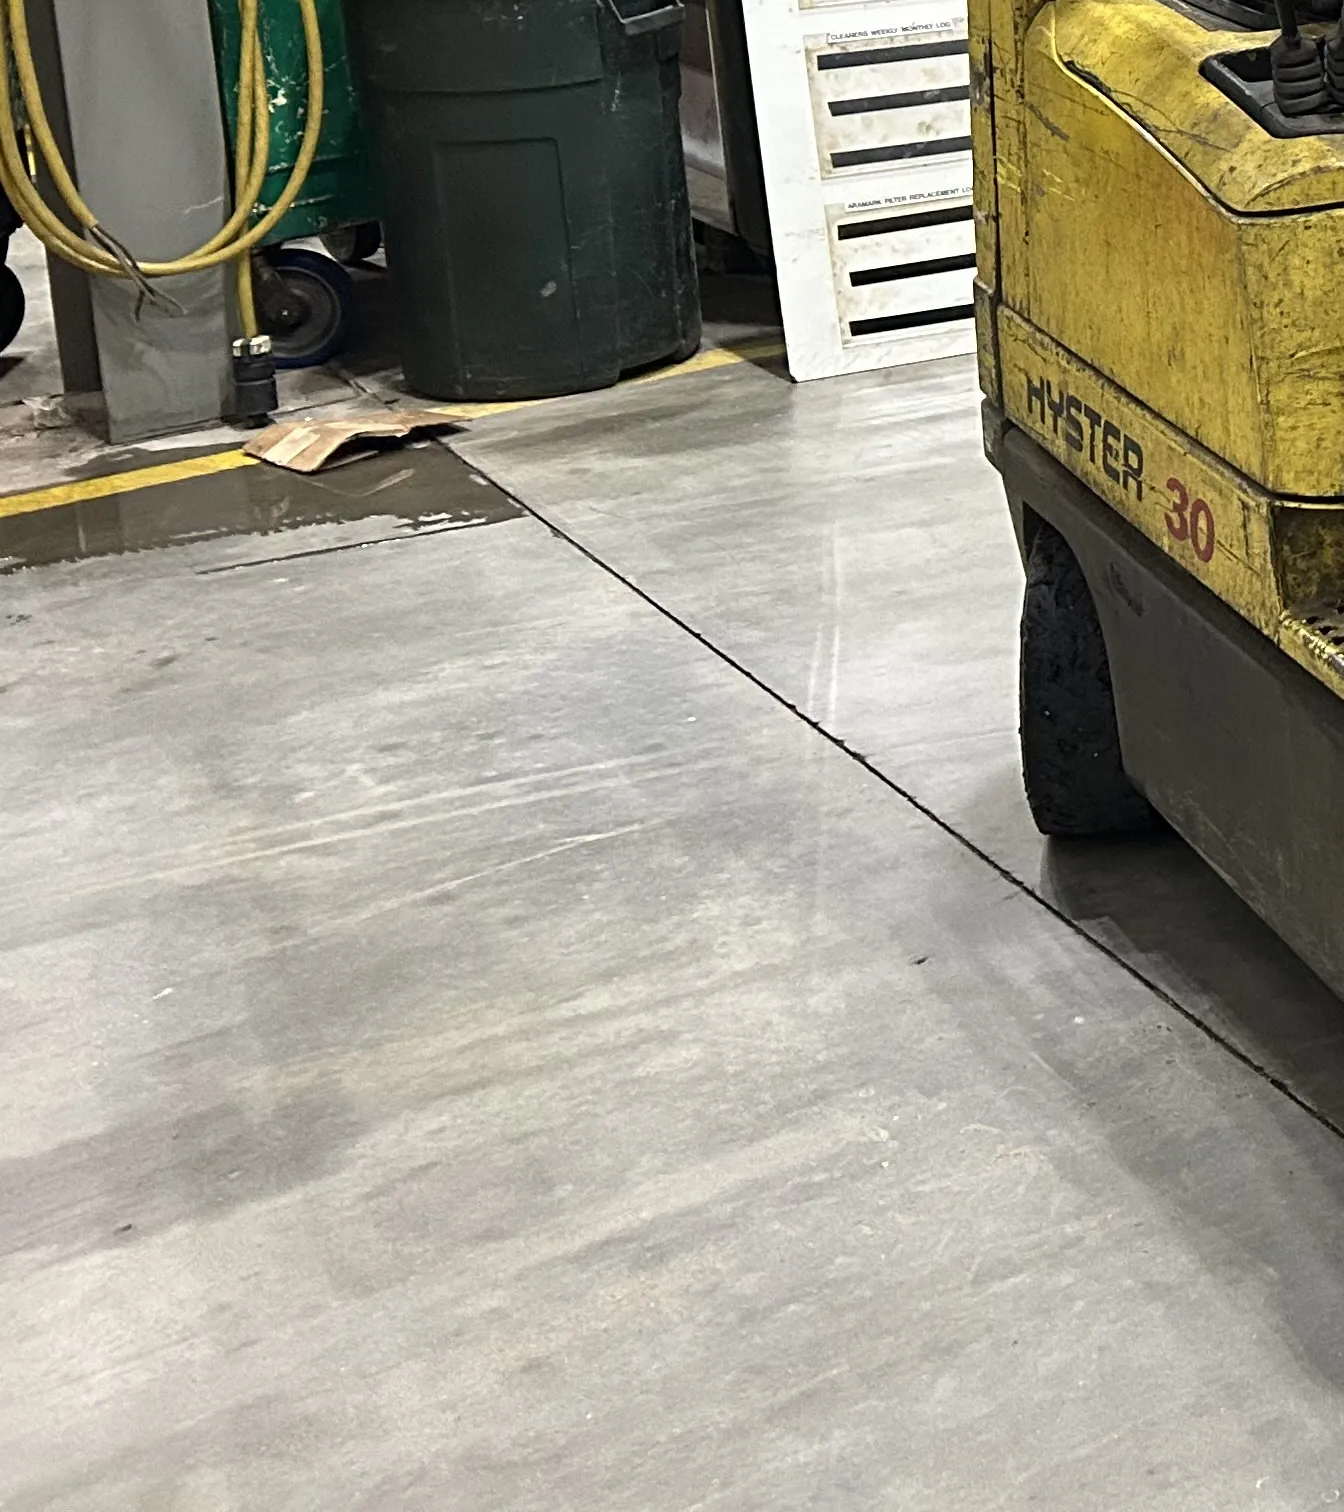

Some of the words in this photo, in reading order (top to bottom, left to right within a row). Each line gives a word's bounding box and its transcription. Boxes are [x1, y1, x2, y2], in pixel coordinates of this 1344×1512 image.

[830, 30, 869, 41] CLEANERS
[870, 27, 899, 36] WEEKLY
[847, 199, 882, 209] ARAMARK
[884, 195, 907, 204] FILTER
[909, 188, 960, 200] REPLACEMENT
[1025, 374, 1144, 502] HYSTER
[1163, 476, 1216, 564] 30
